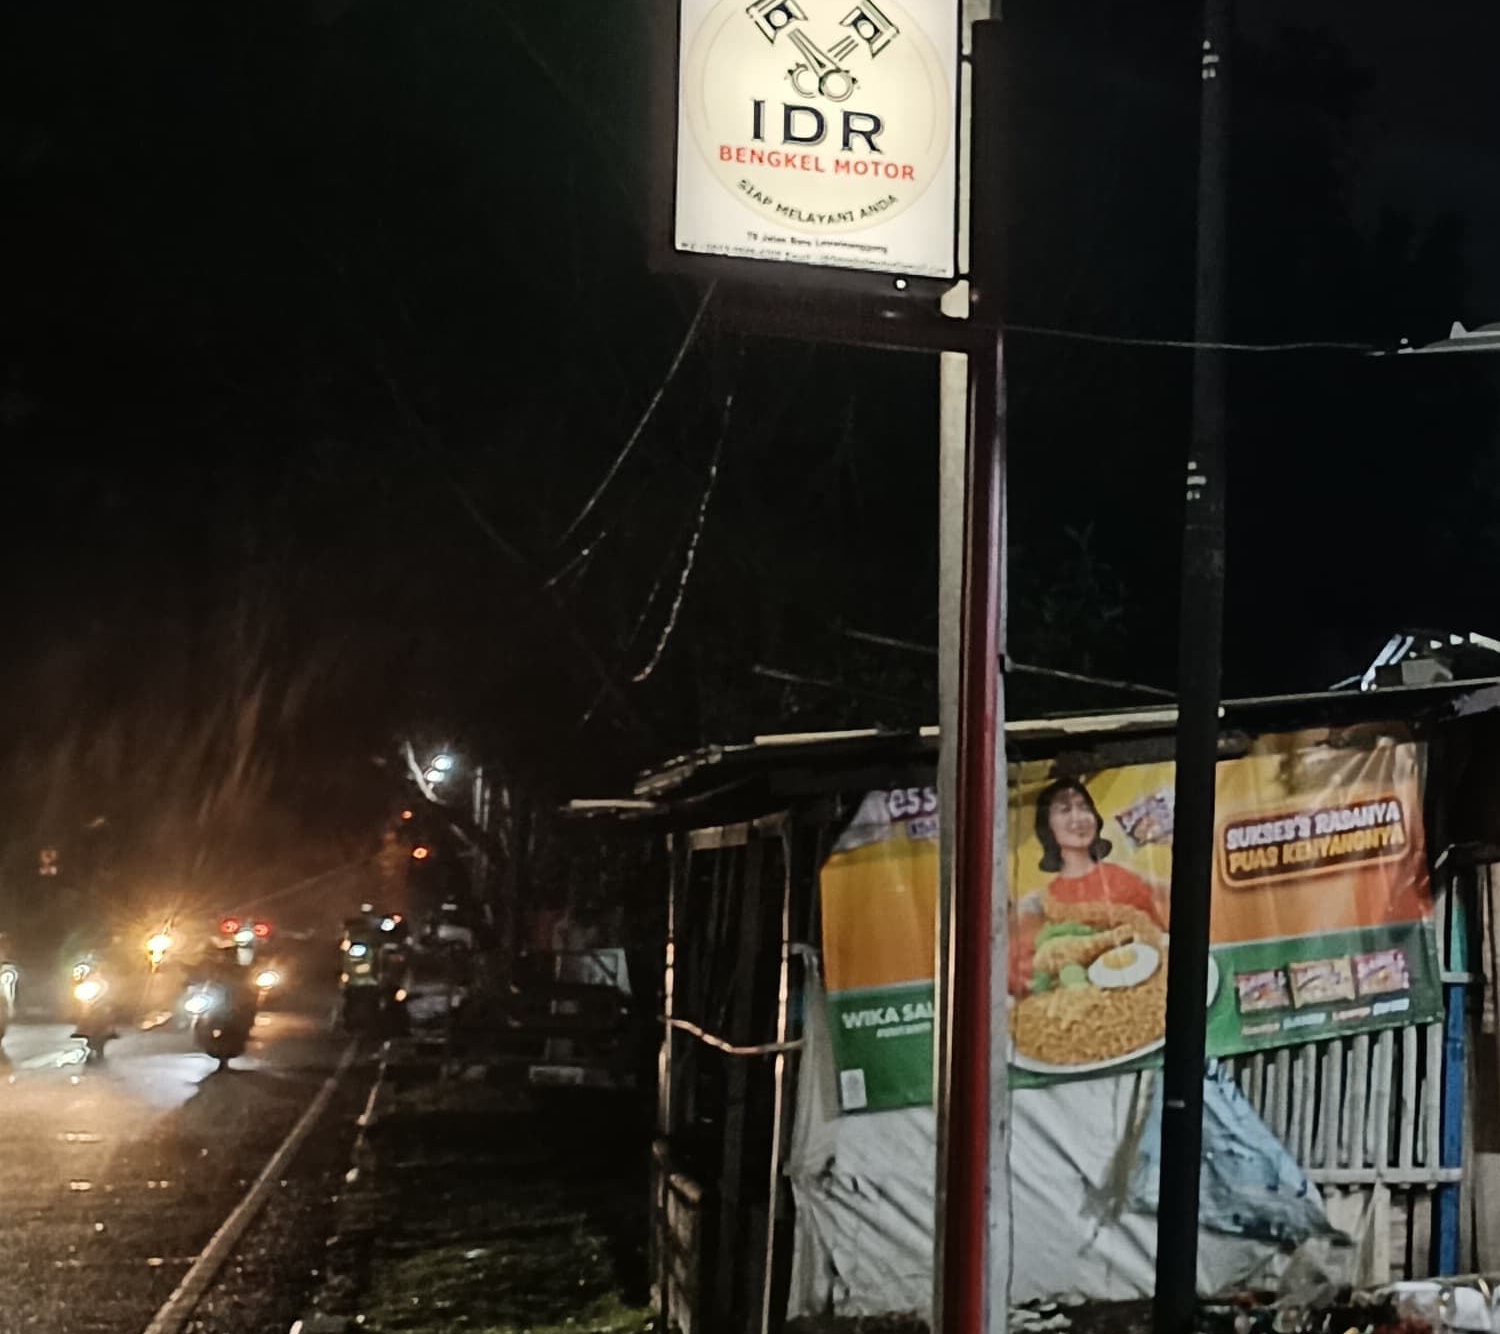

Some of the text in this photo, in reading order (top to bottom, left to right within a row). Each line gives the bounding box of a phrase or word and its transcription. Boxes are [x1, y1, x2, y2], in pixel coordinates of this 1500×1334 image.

[752, 98, 884, 154] IDR
[719, 145, 916, 181] BENGKEL MOTOR
[737, 178, 899, 225] SIAP MELAYANI ANDA
[1314, 800, 1400, 835] RASANYA
[1229, 845, 1279, 874] PUAS
